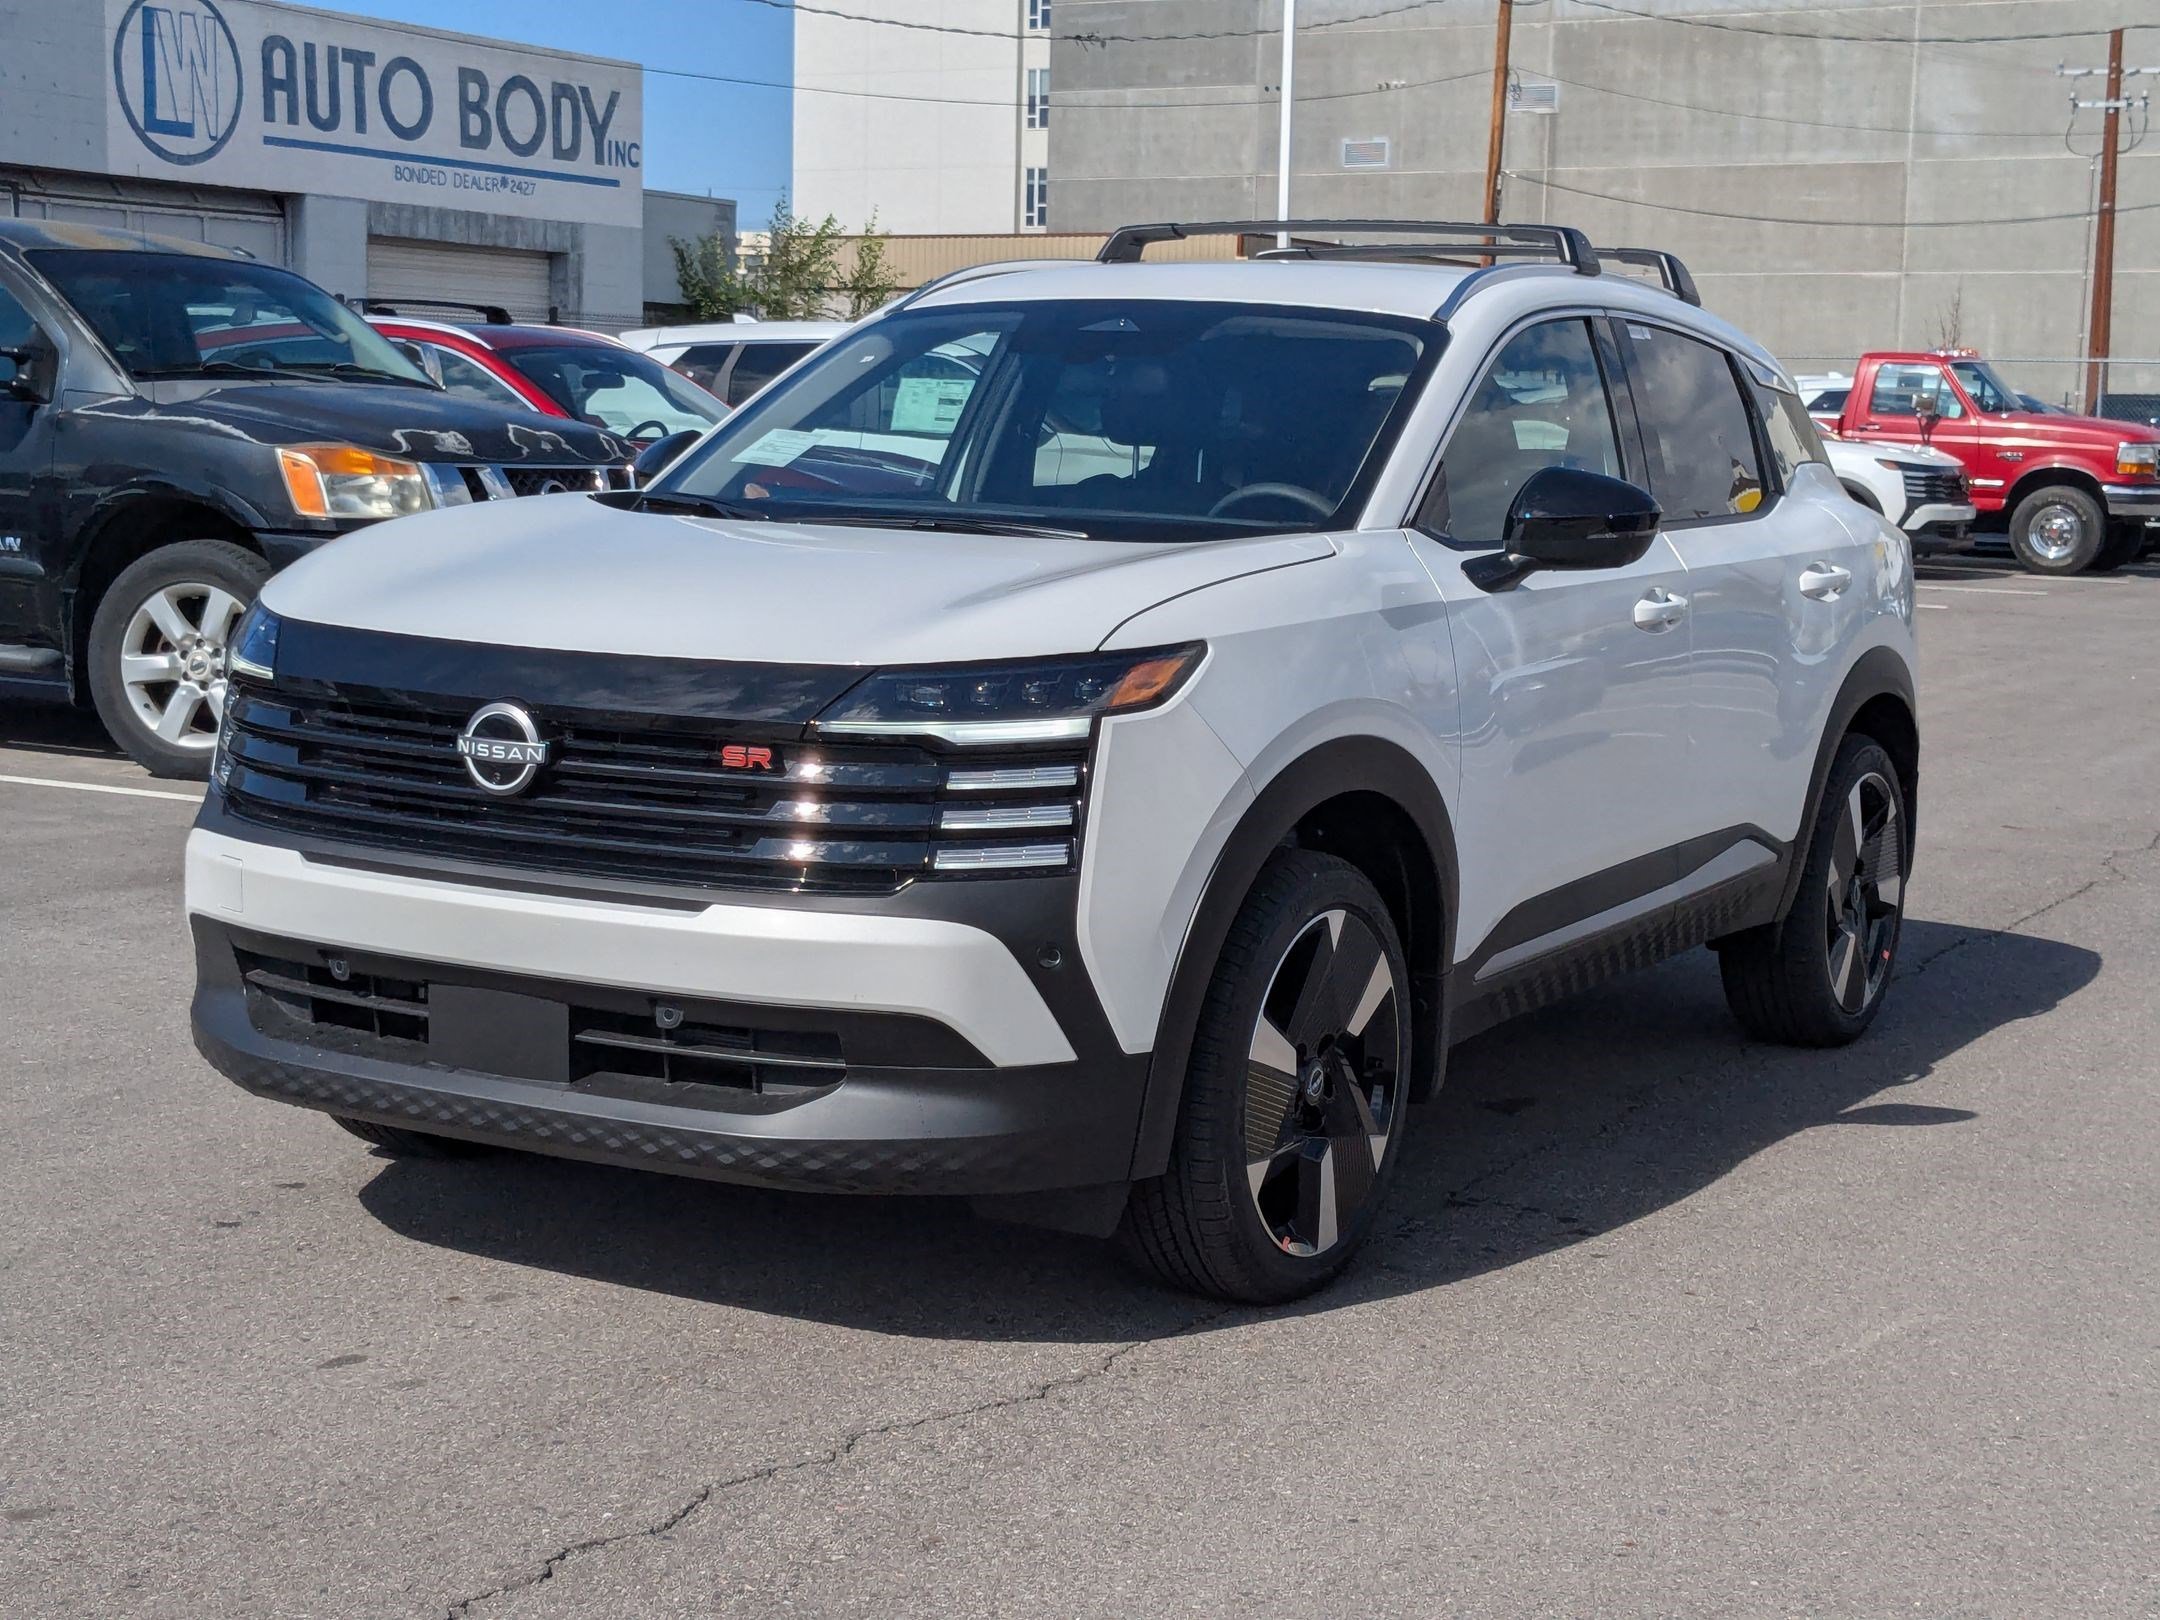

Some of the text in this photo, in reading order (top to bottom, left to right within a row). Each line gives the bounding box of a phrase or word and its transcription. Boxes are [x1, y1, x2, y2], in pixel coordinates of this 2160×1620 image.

[261, 35, 641, 168] AUTO BODY INC
[394, 165, 447, 186] BONDED
[458, 739, 543, 761] NISSAN
[722, 745, 772, 769] SR
